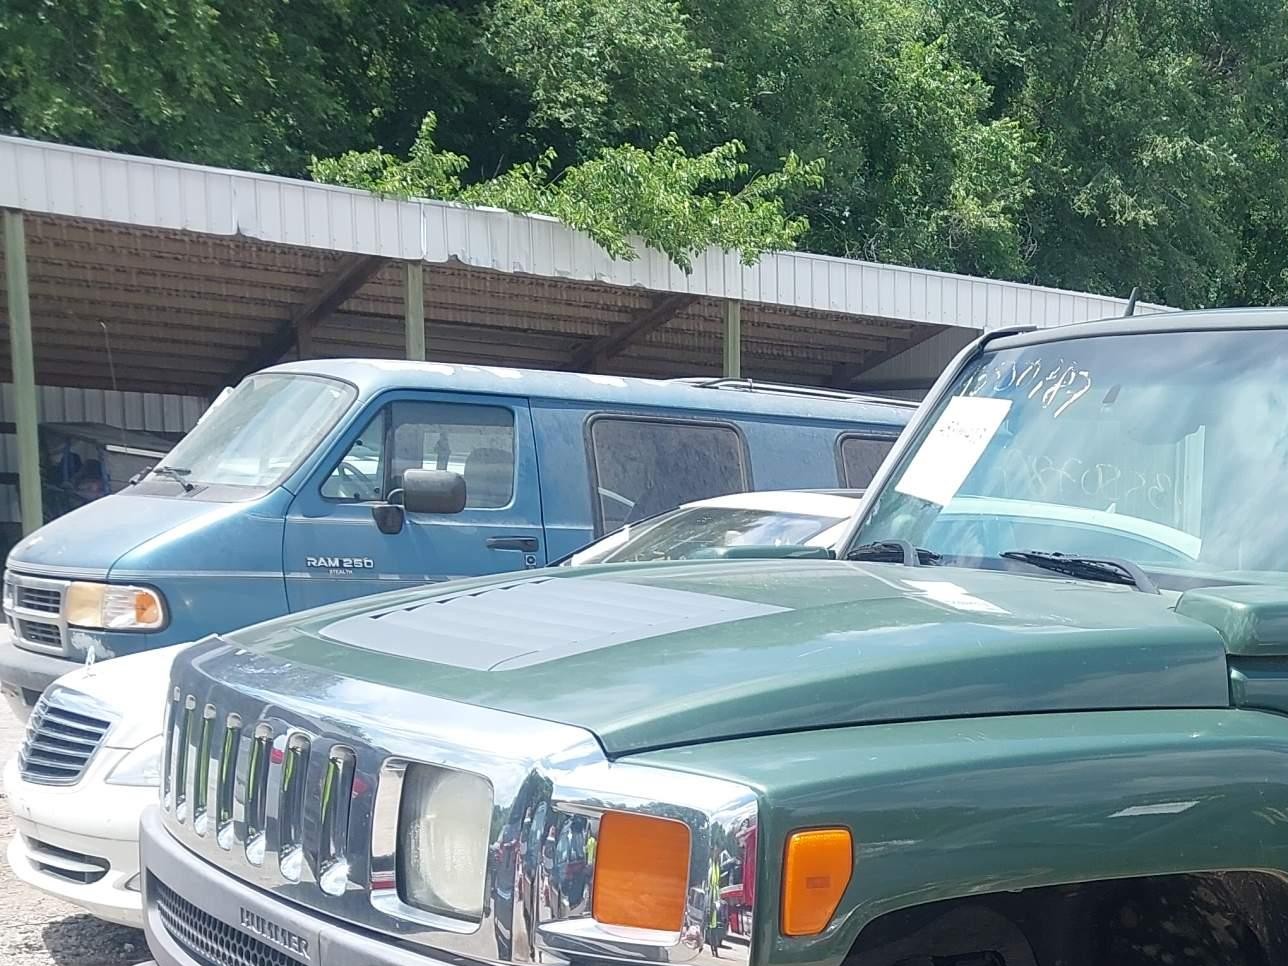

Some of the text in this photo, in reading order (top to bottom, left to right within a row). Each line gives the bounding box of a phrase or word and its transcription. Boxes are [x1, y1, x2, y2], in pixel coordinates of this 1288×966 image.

[306, 556, 374, 568] RAM 250
[328, 568, 353, 576] STEALTH
[240, 906, 311, 960] HUMMER
